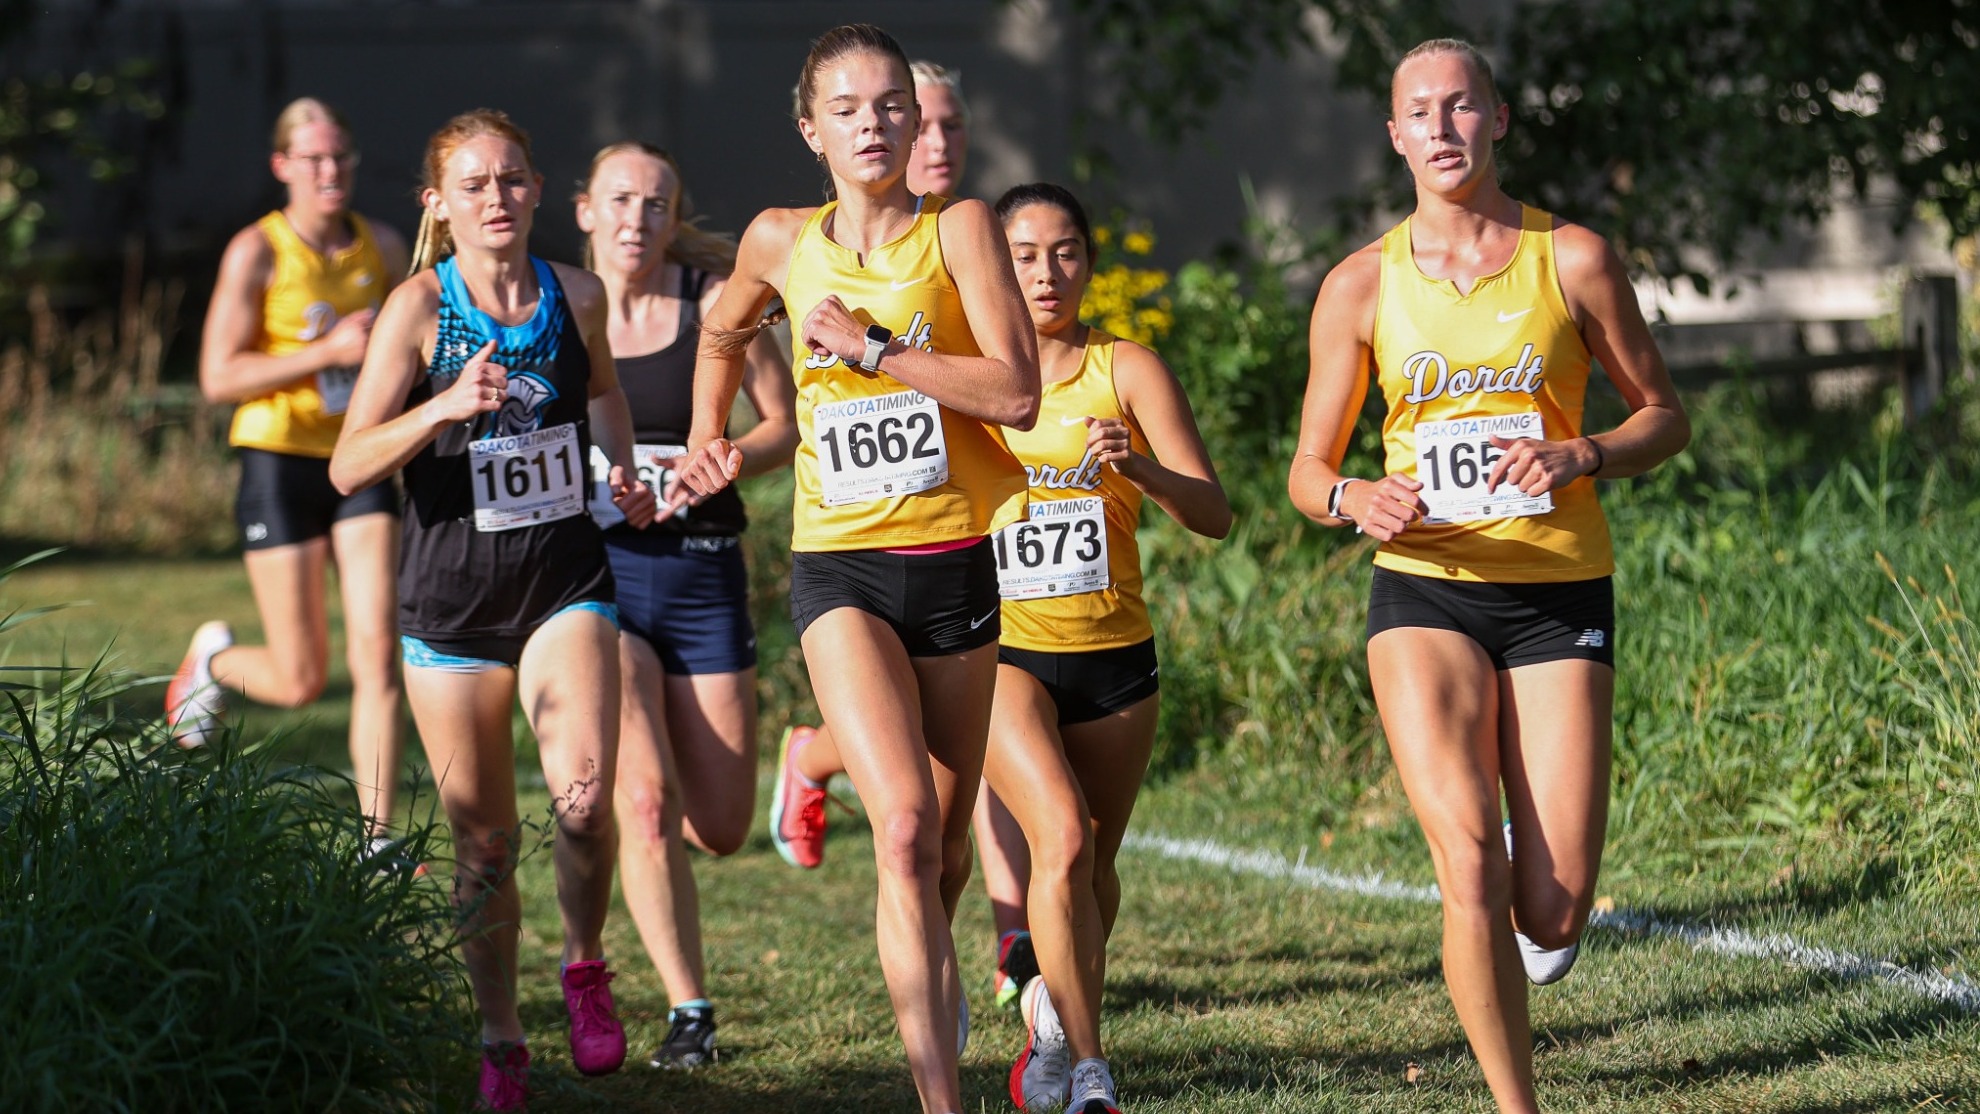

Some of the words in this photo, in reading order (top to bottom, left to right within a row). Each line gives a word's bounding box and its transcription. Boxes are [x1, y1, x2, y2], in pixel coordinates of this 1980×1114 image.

[1402, 343, 1544, 405] Dordt
[820, 391, 926, 420] DAKOTATIMING
[1421, 415, 1531, 439] DAKOTATIMING
[476, 426, 570, 455] DAKOTATIMING
[820, 412, 940, 472] 1662
[1423, 440, 1510, 491] 165
[477, 444, 573, 502] 1611
[1024, 449, 1103, 491] ordt
[995, 518, 1103, 570] 1673
